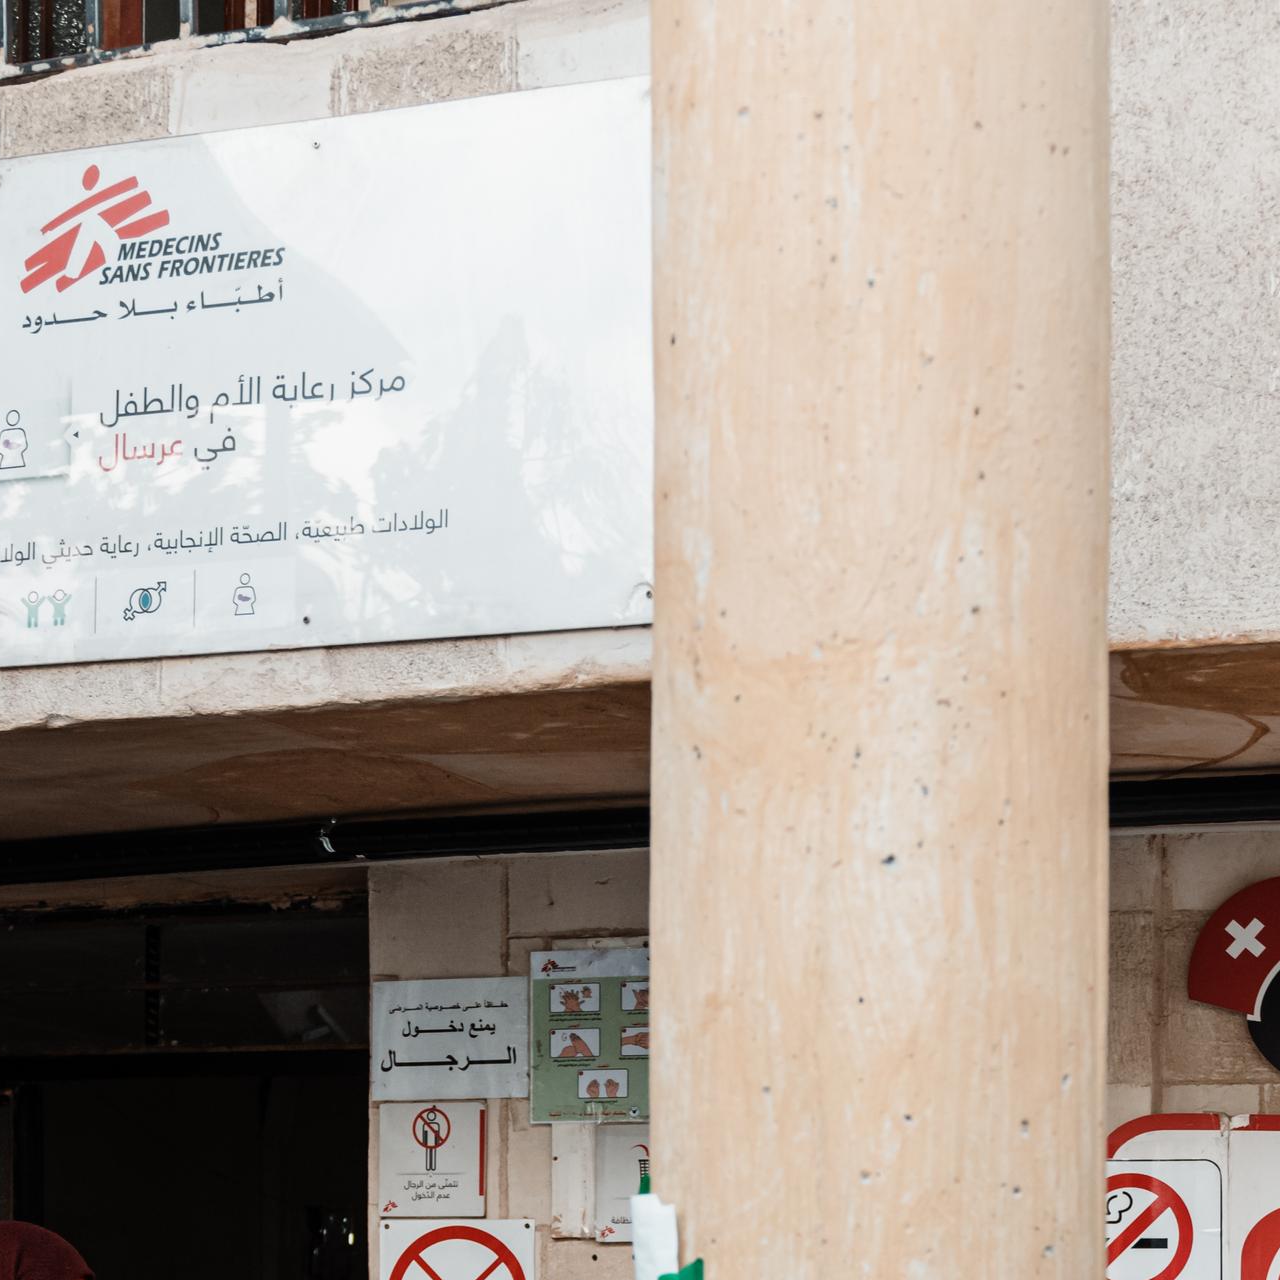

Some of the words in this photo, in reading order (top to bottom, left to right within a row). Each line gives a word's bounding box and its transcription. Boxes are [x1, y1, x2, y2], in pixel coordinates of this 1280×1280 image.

[117, 232, 222, 261] MEDECINS
[98, 261, 153, 286] SANS
[157, 247, 285, 279] FRONTIERES
[21, 309, 109, 335] حدود
[117, 297, 179, 321] بلا
[98, 434, 184, 472] عرسال
[194, 427, 237, 470] في
[401, 1019, 465, 1038] دخول
[468, 1018, 496, 1039] يمنع
[380, 1046, 516, 1072] الرجال
